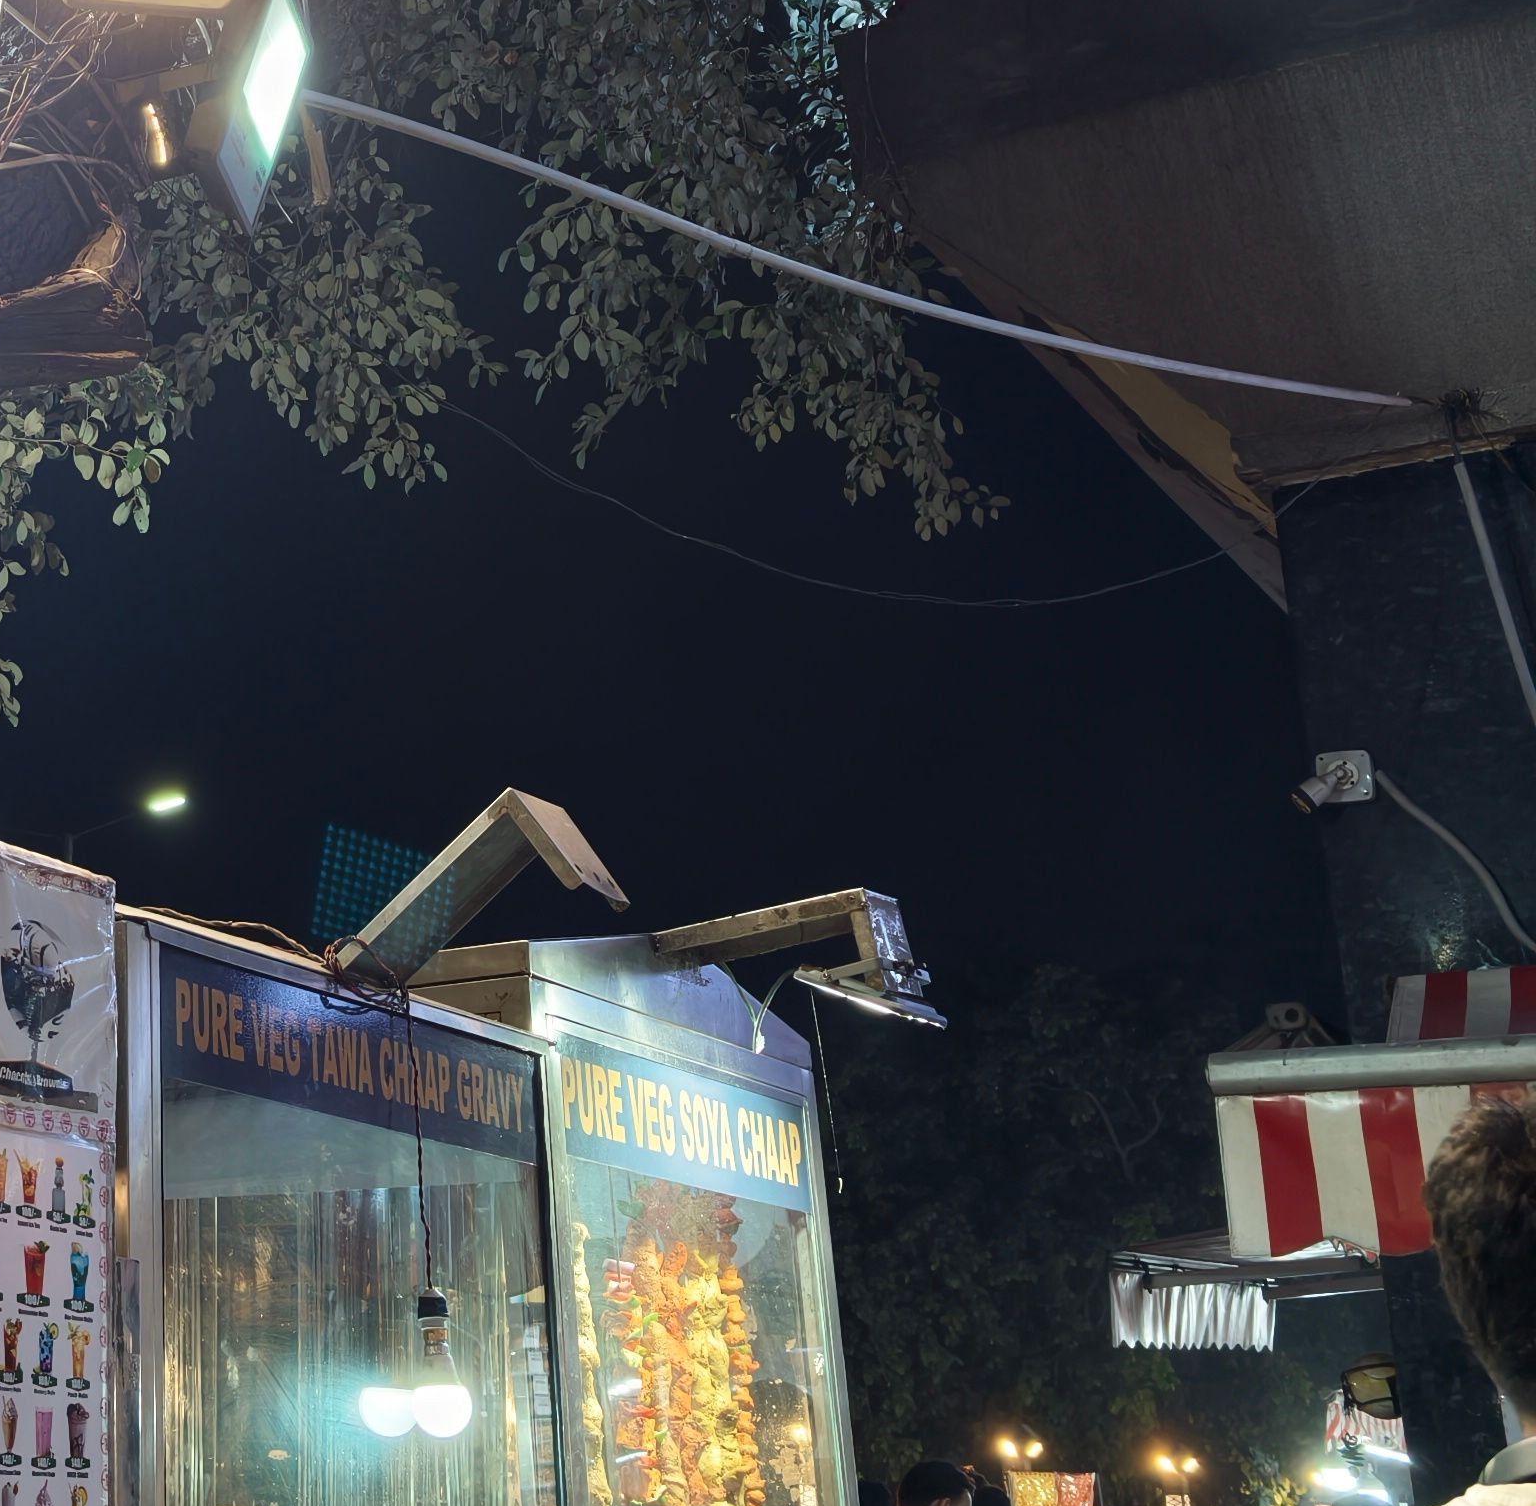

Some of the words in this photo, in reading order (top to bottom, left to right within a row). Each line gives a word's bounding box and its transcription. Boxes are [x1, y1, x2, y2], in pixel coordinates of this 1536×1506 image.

[174, 977, 245, 1061] PURE
[248, 997, 301, 1077] VEG
[307, 1020, 375, 1095] TAWA
[378, 1037, 451, 1115] CHAAP
[455, 1058, 526, 1134] GRAVY
[563, 1055, 627, 1143] PURE
[627, 1073, 676, 1157] VEG
[678, 1089, 735, 1170] SOYA
[737, 1106, 802, 1188] CHAAP
